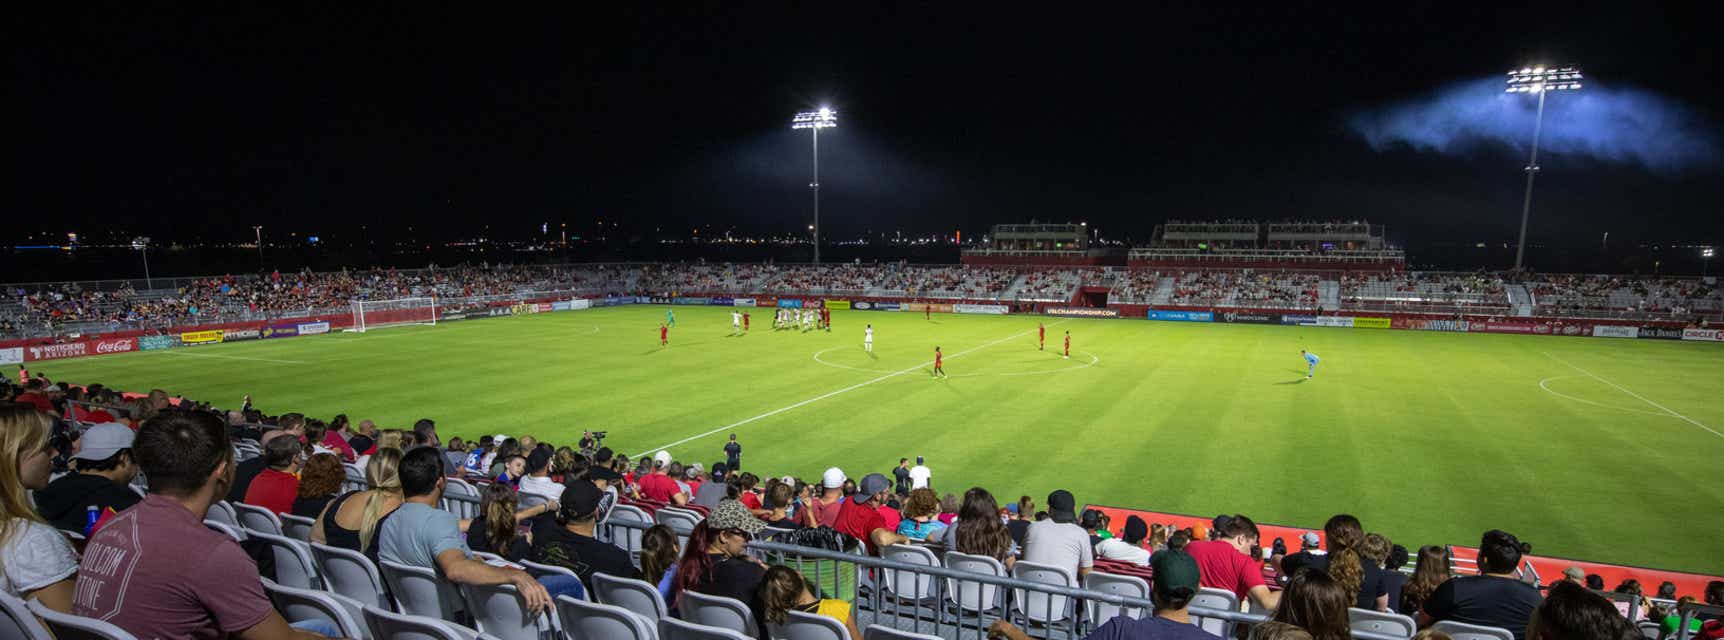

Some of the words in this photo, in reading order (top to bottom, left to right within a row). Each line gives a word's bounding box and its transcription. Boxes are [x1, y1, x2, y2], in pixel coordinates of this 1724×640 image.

[1684, 330, 1714, 338] CIRCLE
[44, 342, 86, 353] NOTICIERO
[45, 350, 86, 359] ARIZONA
